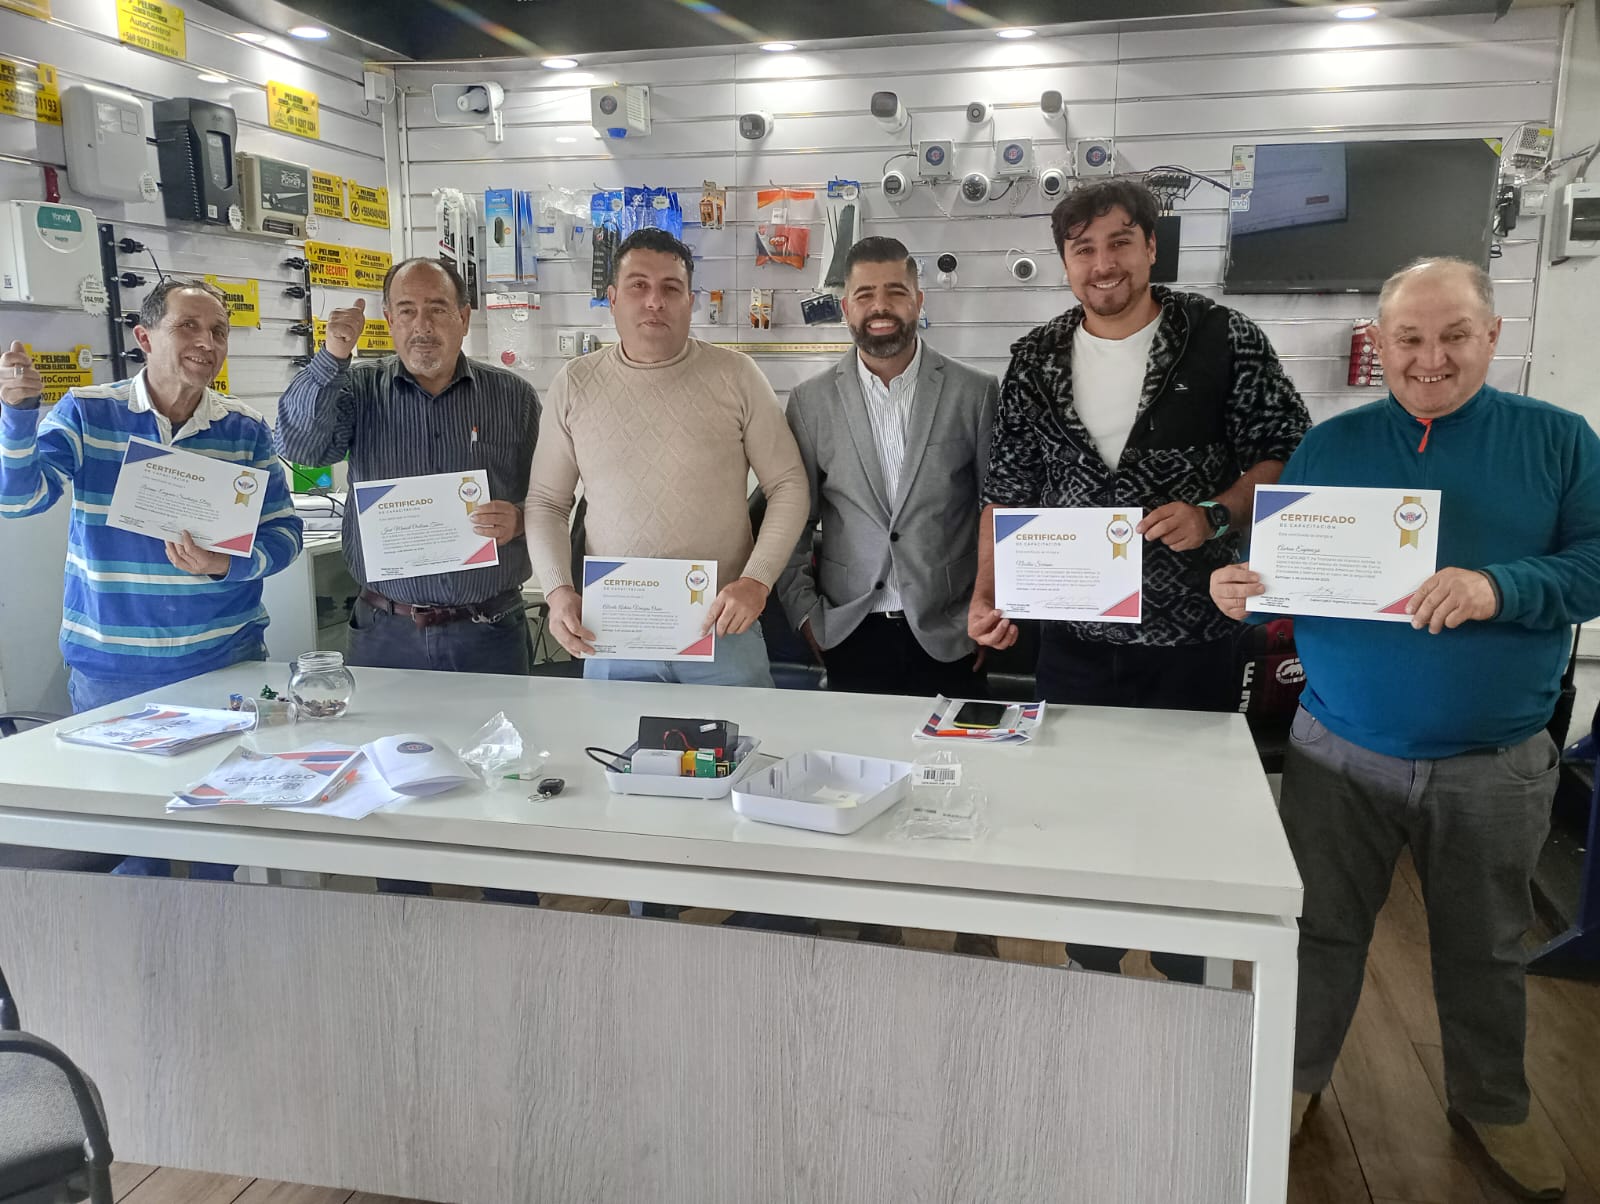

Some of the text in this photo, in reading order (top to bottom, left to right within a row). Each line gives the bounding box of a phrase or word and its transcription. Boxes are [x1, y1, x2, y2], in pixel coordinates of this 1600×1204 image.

[130, 15, 171, 37] AutoControl
[325, 264, 349, 279] SECURITY
[41, 354, 71, 363] PELIGRO
[146, 462, 206, 482] CERTIFICADO
[378, 498, 434, 510] CERTIFICADO
[1280, 512, 1356, 525] CERTIFICADO
[1015, 533, 1077, 541] CERTIFICADO
[603, 579, 660, 588] CERTIFICADO
